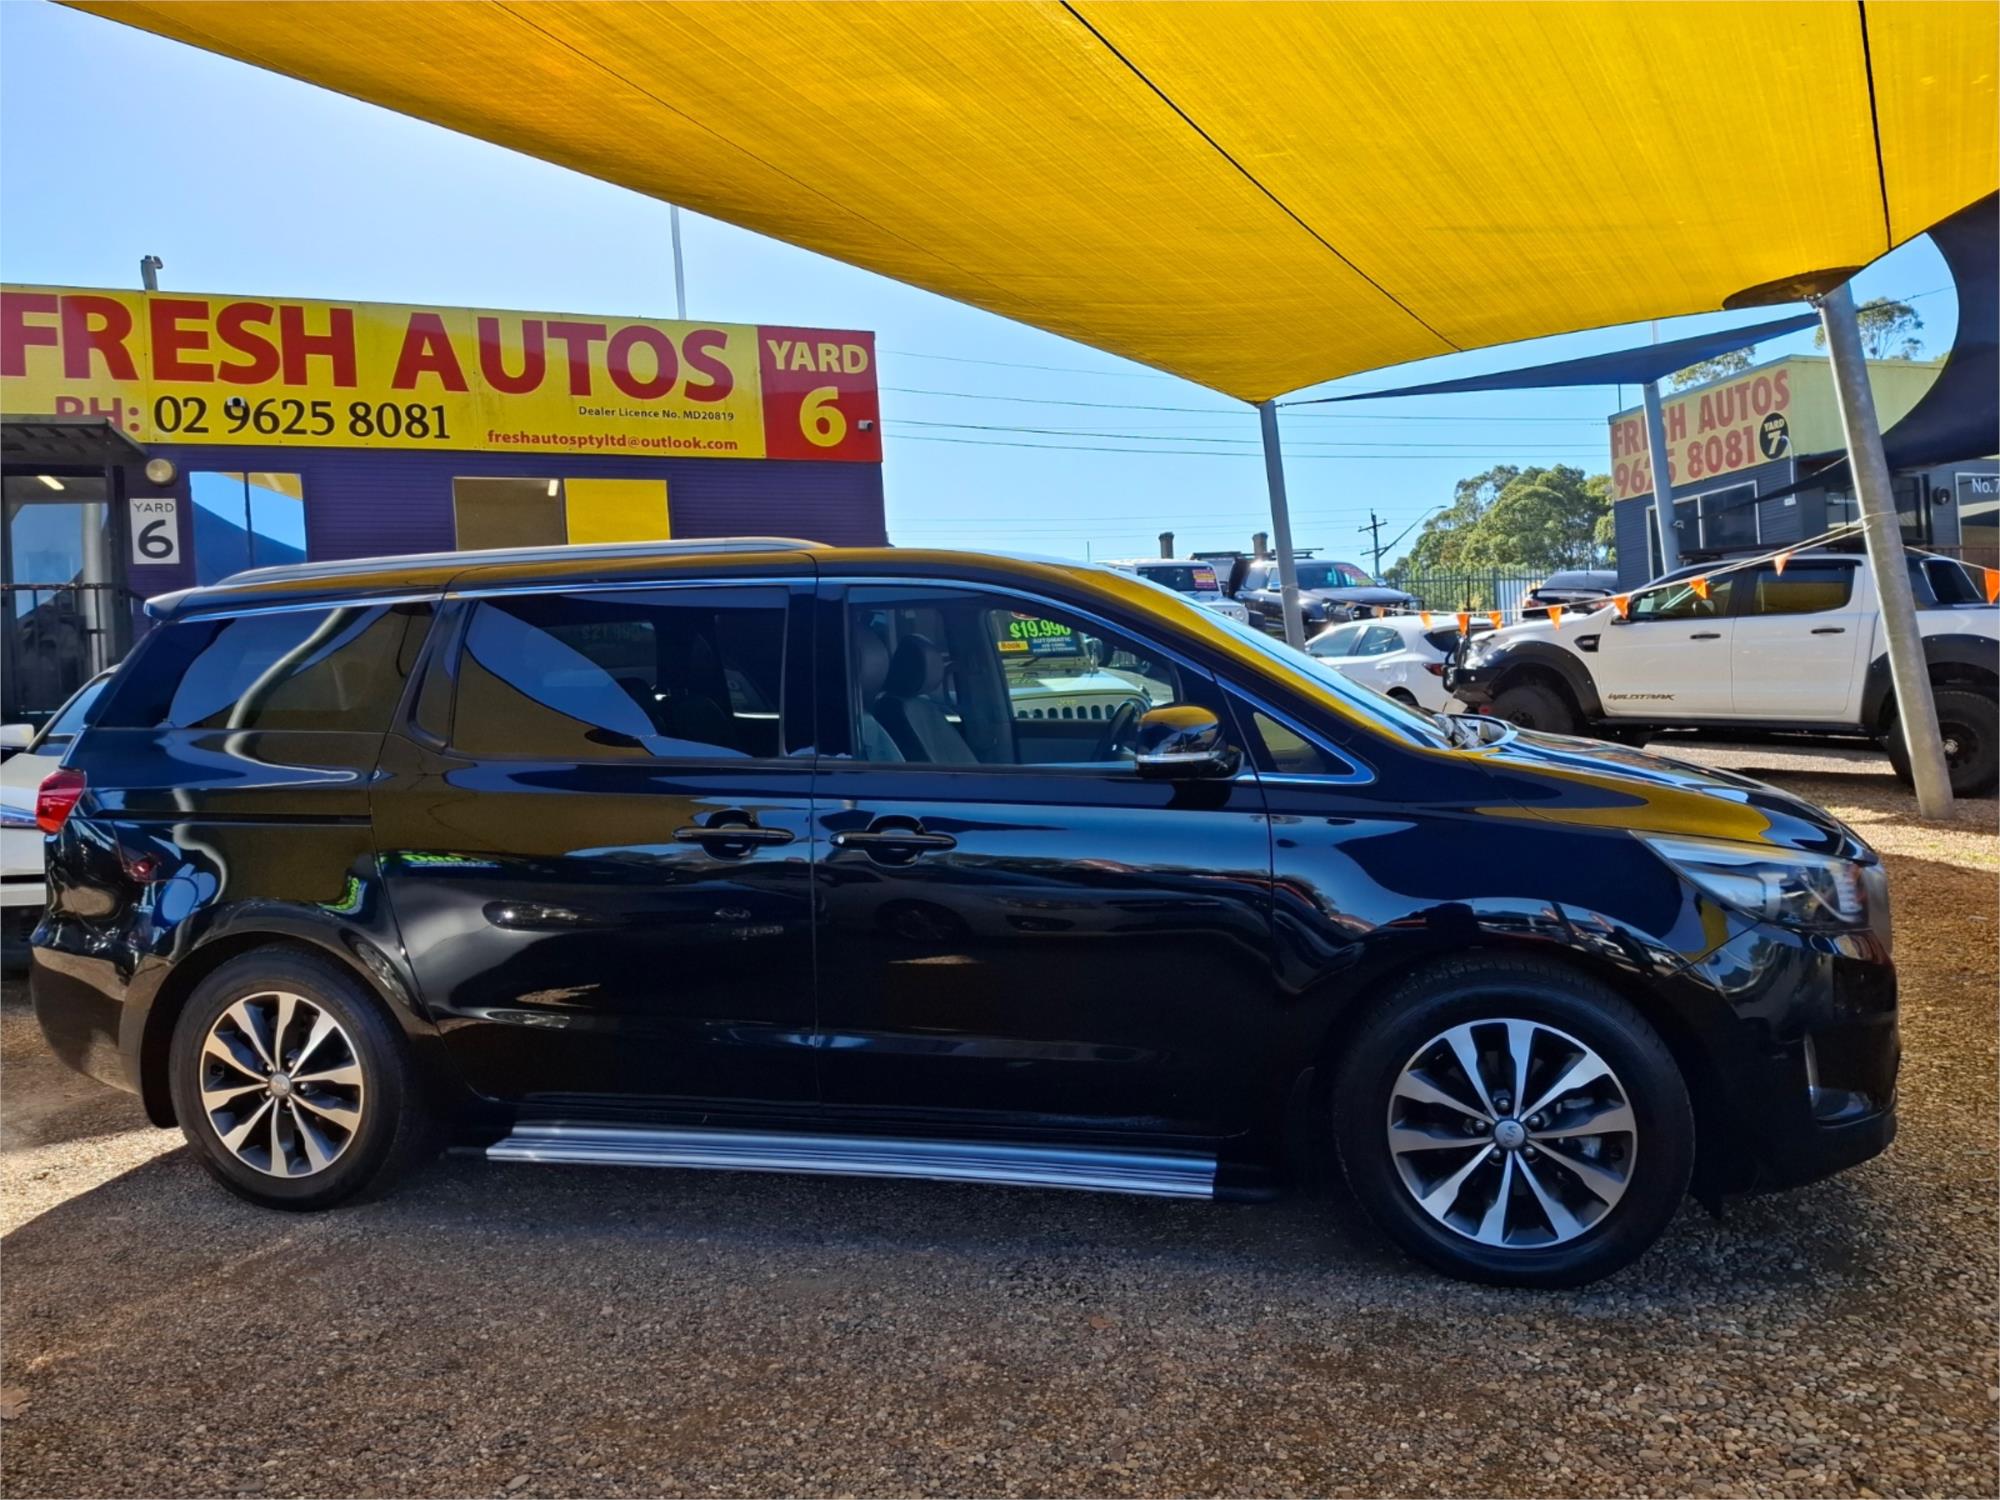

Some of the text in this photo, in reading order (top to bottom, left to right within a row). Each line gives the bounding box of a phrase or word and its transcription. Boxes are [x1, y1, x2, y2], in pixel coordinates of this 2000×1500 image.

[0, 292, 734, 402] FRESH AUTOS
[766, 340, 869, 374] YARD
[154, 396, 209, 433] 02
[223, 398, 335, 436] 9625
[349, 402, 450, 440] 8081
[579, 406, 734, 421] Dealer Licence No. MD20819
[799, 386, 847, 447] 6
[1698, 369, 1790, 434] AUTOS
[487, 430, 738, 450] freshautosptyltd@outlook.com
[1764, 418, 1785, 432] YARD
[1767, 430, 1781, 455] 7
[1687, 425, 1755, 478] 8081
[134, 502, 174, 513] YARD
[138, 519, 174, 559] 6
